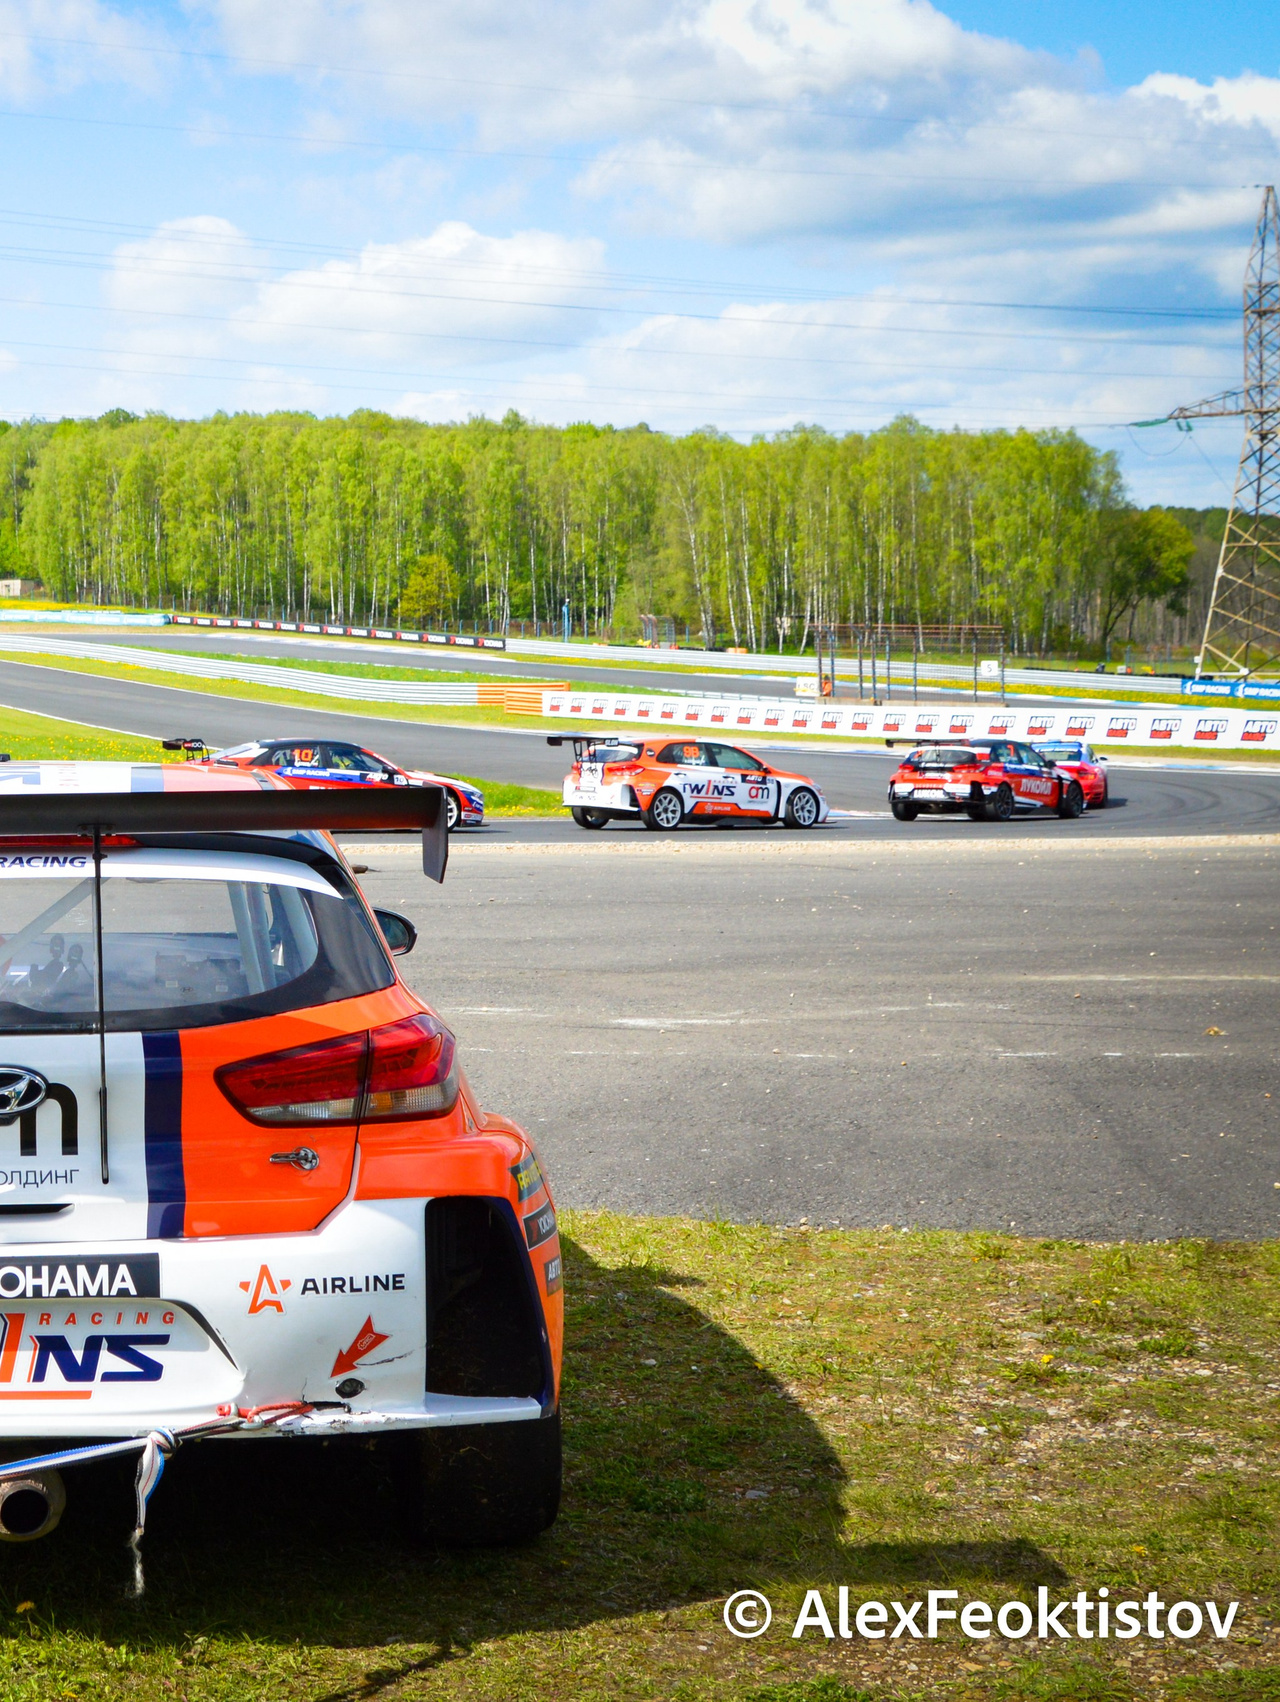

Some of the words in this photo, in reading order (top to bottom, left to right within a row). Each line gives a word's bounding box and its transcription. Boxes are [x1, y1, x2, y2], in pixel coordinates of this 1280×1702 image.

[1151, 718, 1182, 731] АВТО
[1196, 719, 1228, 733] АВТО
[1243, 720, 1278, 734] АВТО
[293, 748, 313, 762] 10
[300, 1272, 406, 1296] AIRLINE
[37, 1310, 176, 1327] RACING
